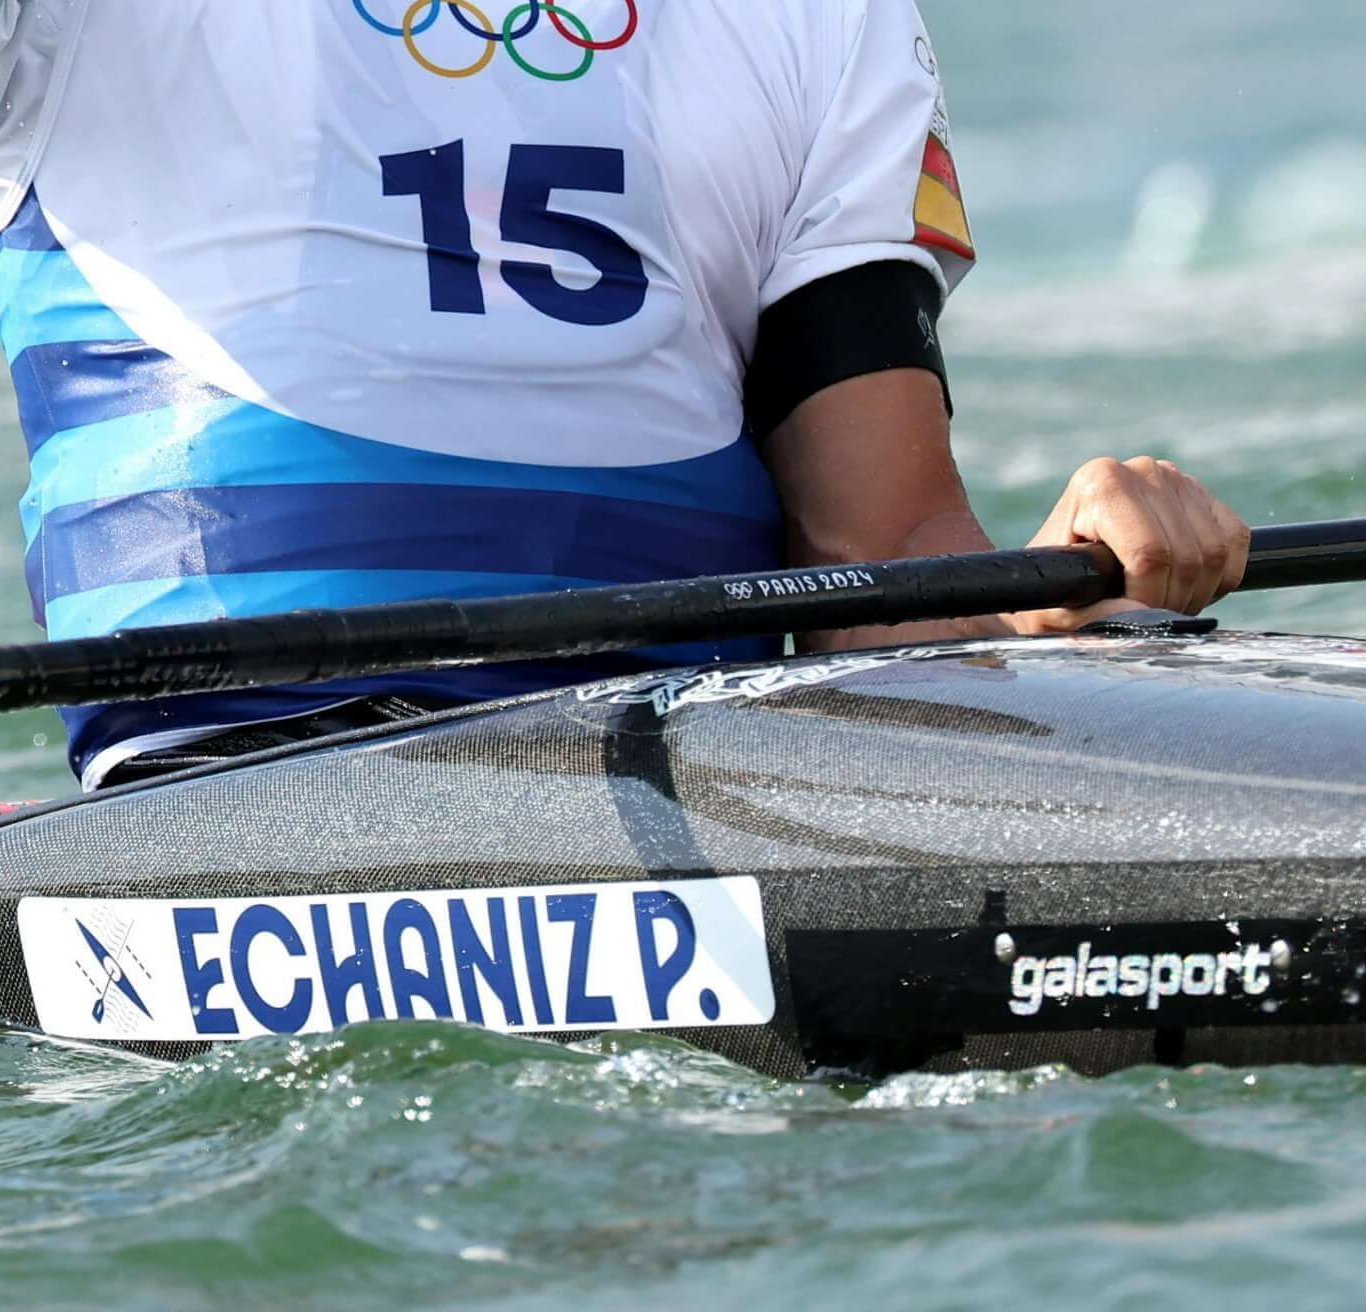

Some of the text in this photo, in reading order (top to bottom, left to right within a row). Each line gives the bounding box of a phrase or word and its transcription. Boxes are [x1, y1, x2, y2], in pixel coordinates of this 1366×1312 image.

[378, 137, 649, 326] 15
[818, 569, 875, 591] 2024
[171, 889, 721, 1035] ECHANIZ P.
[1008, 940, 1272, 1016] galasport
